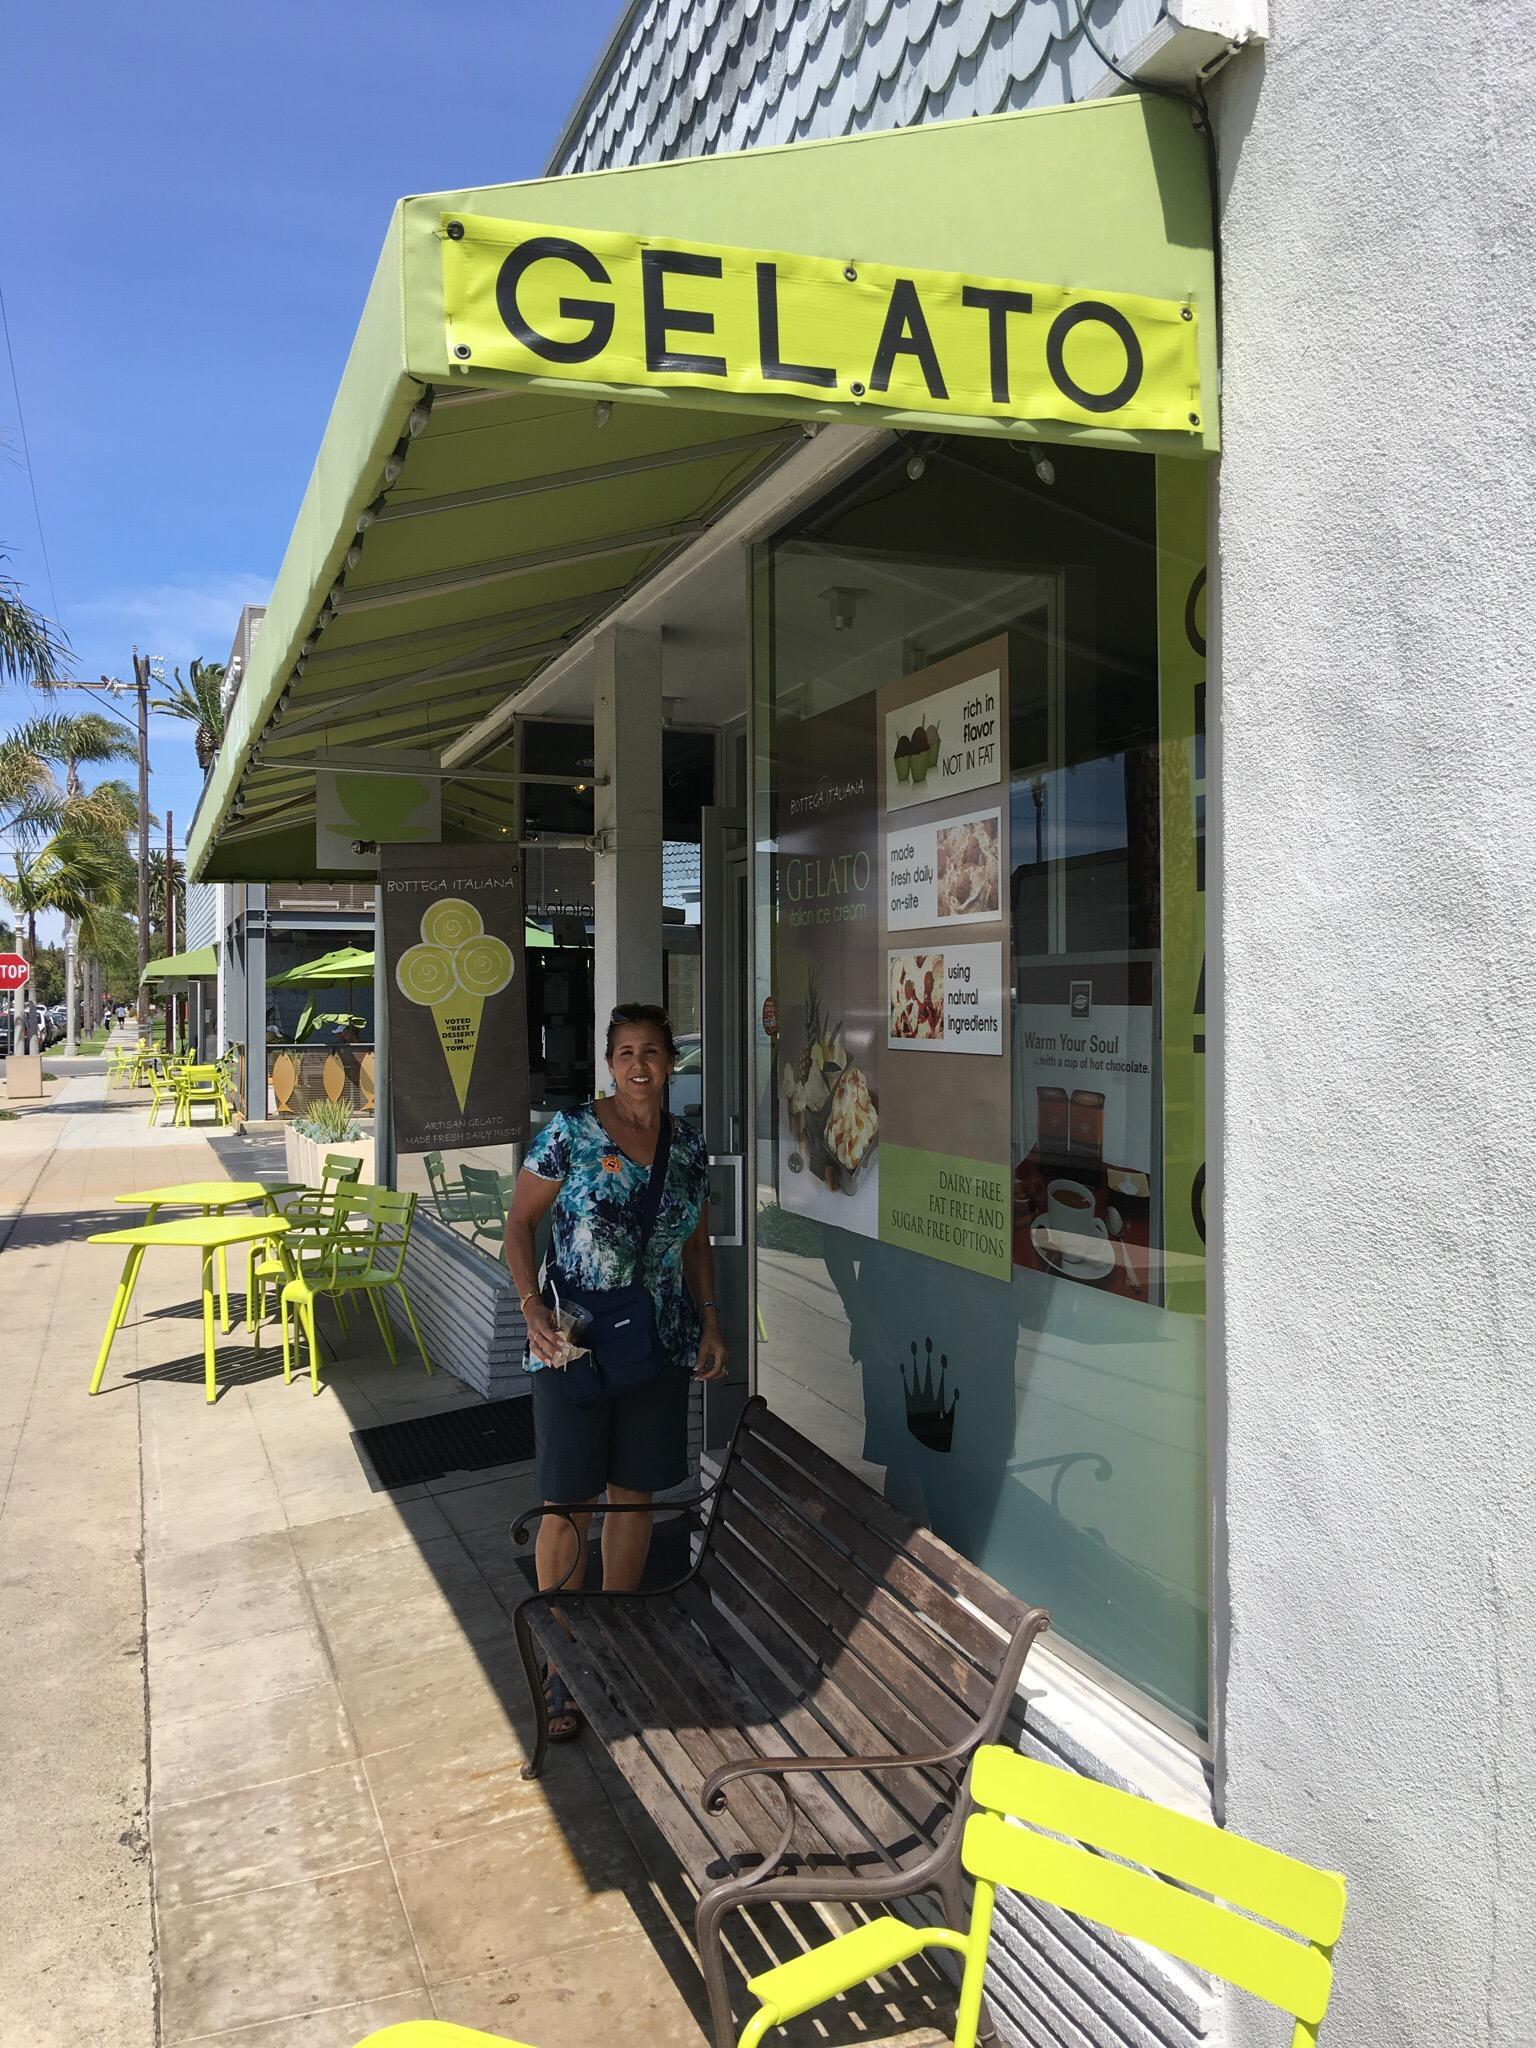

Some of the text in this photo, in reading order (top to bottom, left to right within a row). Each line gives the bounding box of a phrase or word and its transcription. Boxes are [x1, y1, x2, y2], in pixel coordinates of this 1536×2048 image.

[496, 236, 1144, 413] GELATO
[963, 693, 995, 720] rich in
[963, 720, 994, 743] flavor
[942, 743, 995, 777] NOT IN FAT
[790, 779, 865, 815] BOTTEGA ITALIANA
[890, 843, 915, 862] made
[387, 878, 515, 893] BOTTEGA ITALIANA
[786, 851, 871, 902] GELATO
[890, 865, 934, 887] fresh daily
[816, 906, 831, 924] ice
[834, 901, 867, 921] cream
[890, 893, 919, 912] on-site
[0, 964, 27, 979] TOP
[947, 963, 971, 983] using
[947, 987, 979, 1005] natural
[442, 1031, 476, 1039] DESSERT
[947, 1014, 998, 1035] ingredients
[1024, 1032, 1119, 1054] Warm Your Soul
[1058, 1059, 1063, 1068] a
[1064, 1060, 1078, 1071] cup
[1080, 1057, 1089, 1069] of
[1089, 1058, 1104, 1071] hot
[1105, 1060, 1151, 1075] chocolate.
[424, 1116, 504, 1131] ARTISAN GELATO
[405, 1126, 523, 1146] MADE FRESH DAILY INSIDE
[939, 1170, 973, 1195] DAIRY
[929, 1194, 1005, 1230] FAT FREE AND
[891, 1209, 1005, 1259] SUGAR FREE OPTIONS
